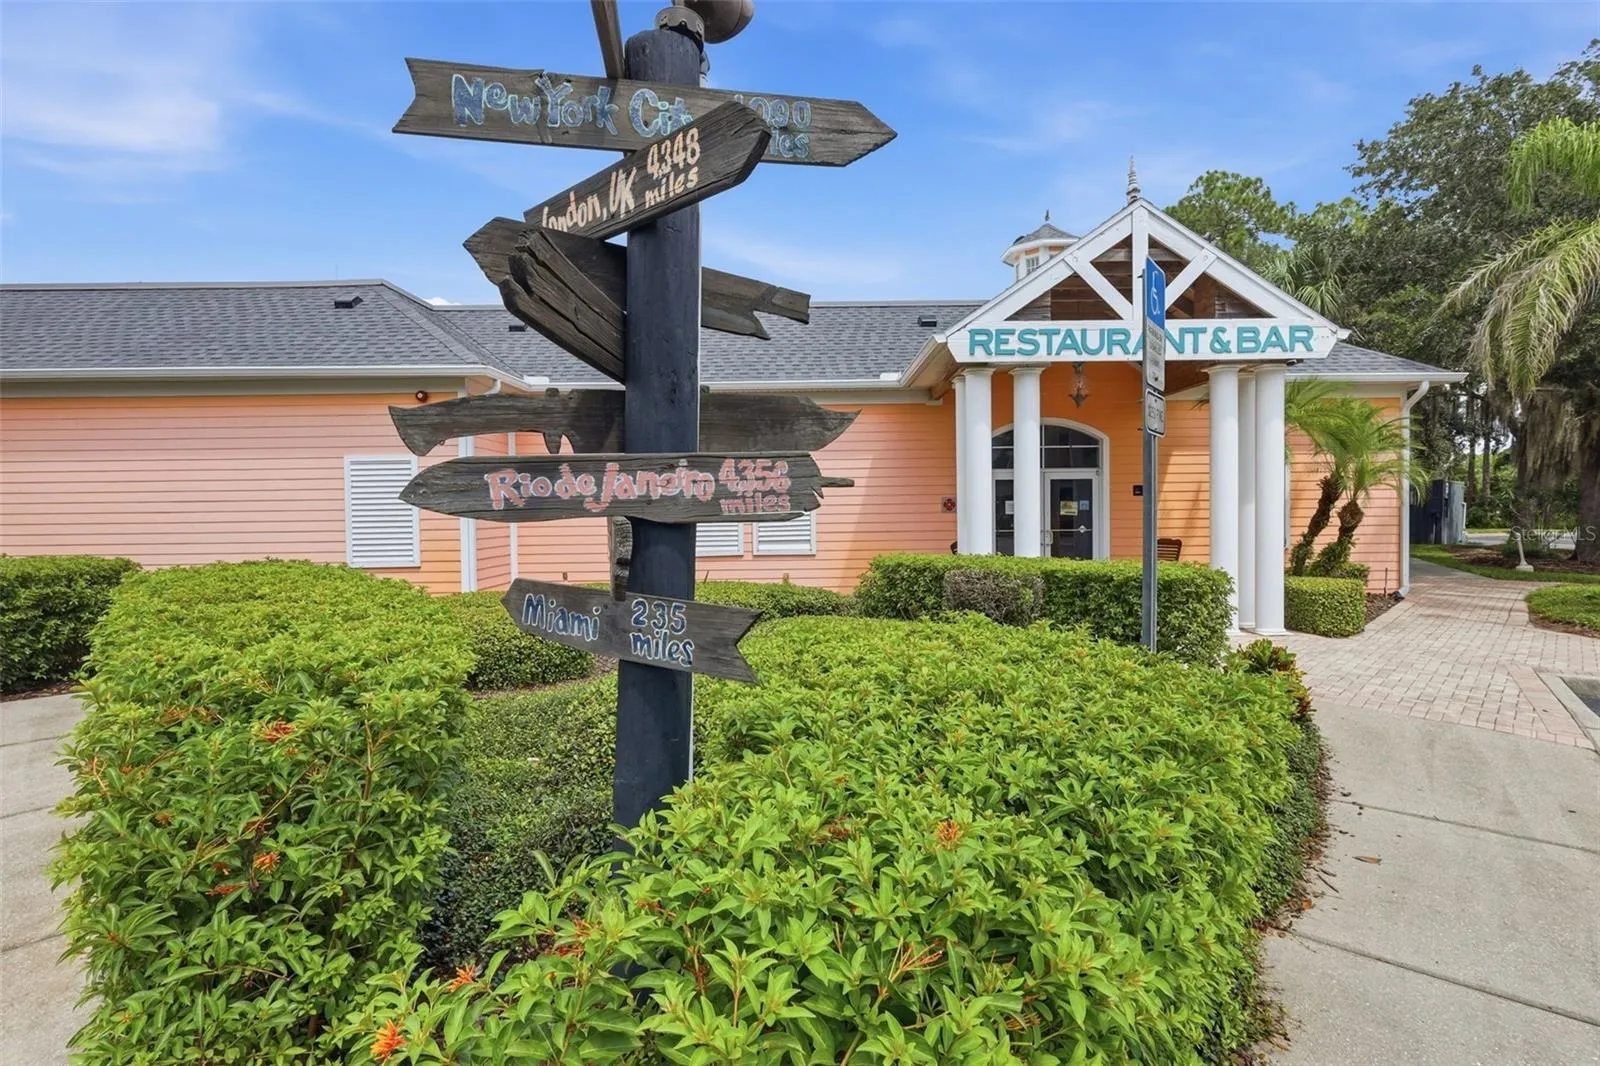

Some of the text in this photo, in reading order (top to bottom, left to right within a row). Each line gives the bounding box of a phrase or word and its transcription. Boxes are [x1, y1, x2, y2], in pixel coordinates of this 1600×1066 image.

[628, 88, 694, 137] Cit
[769, 128, 810, 158] les
[609, 166, 637, 218] UK
[645, 166, 699, 208] miles
[719, 492, 791, 513] miles
[521, 593, 601, 642] Miami
[631, 598, 687, 635] 235
[629, 628, 696, 667] miles
